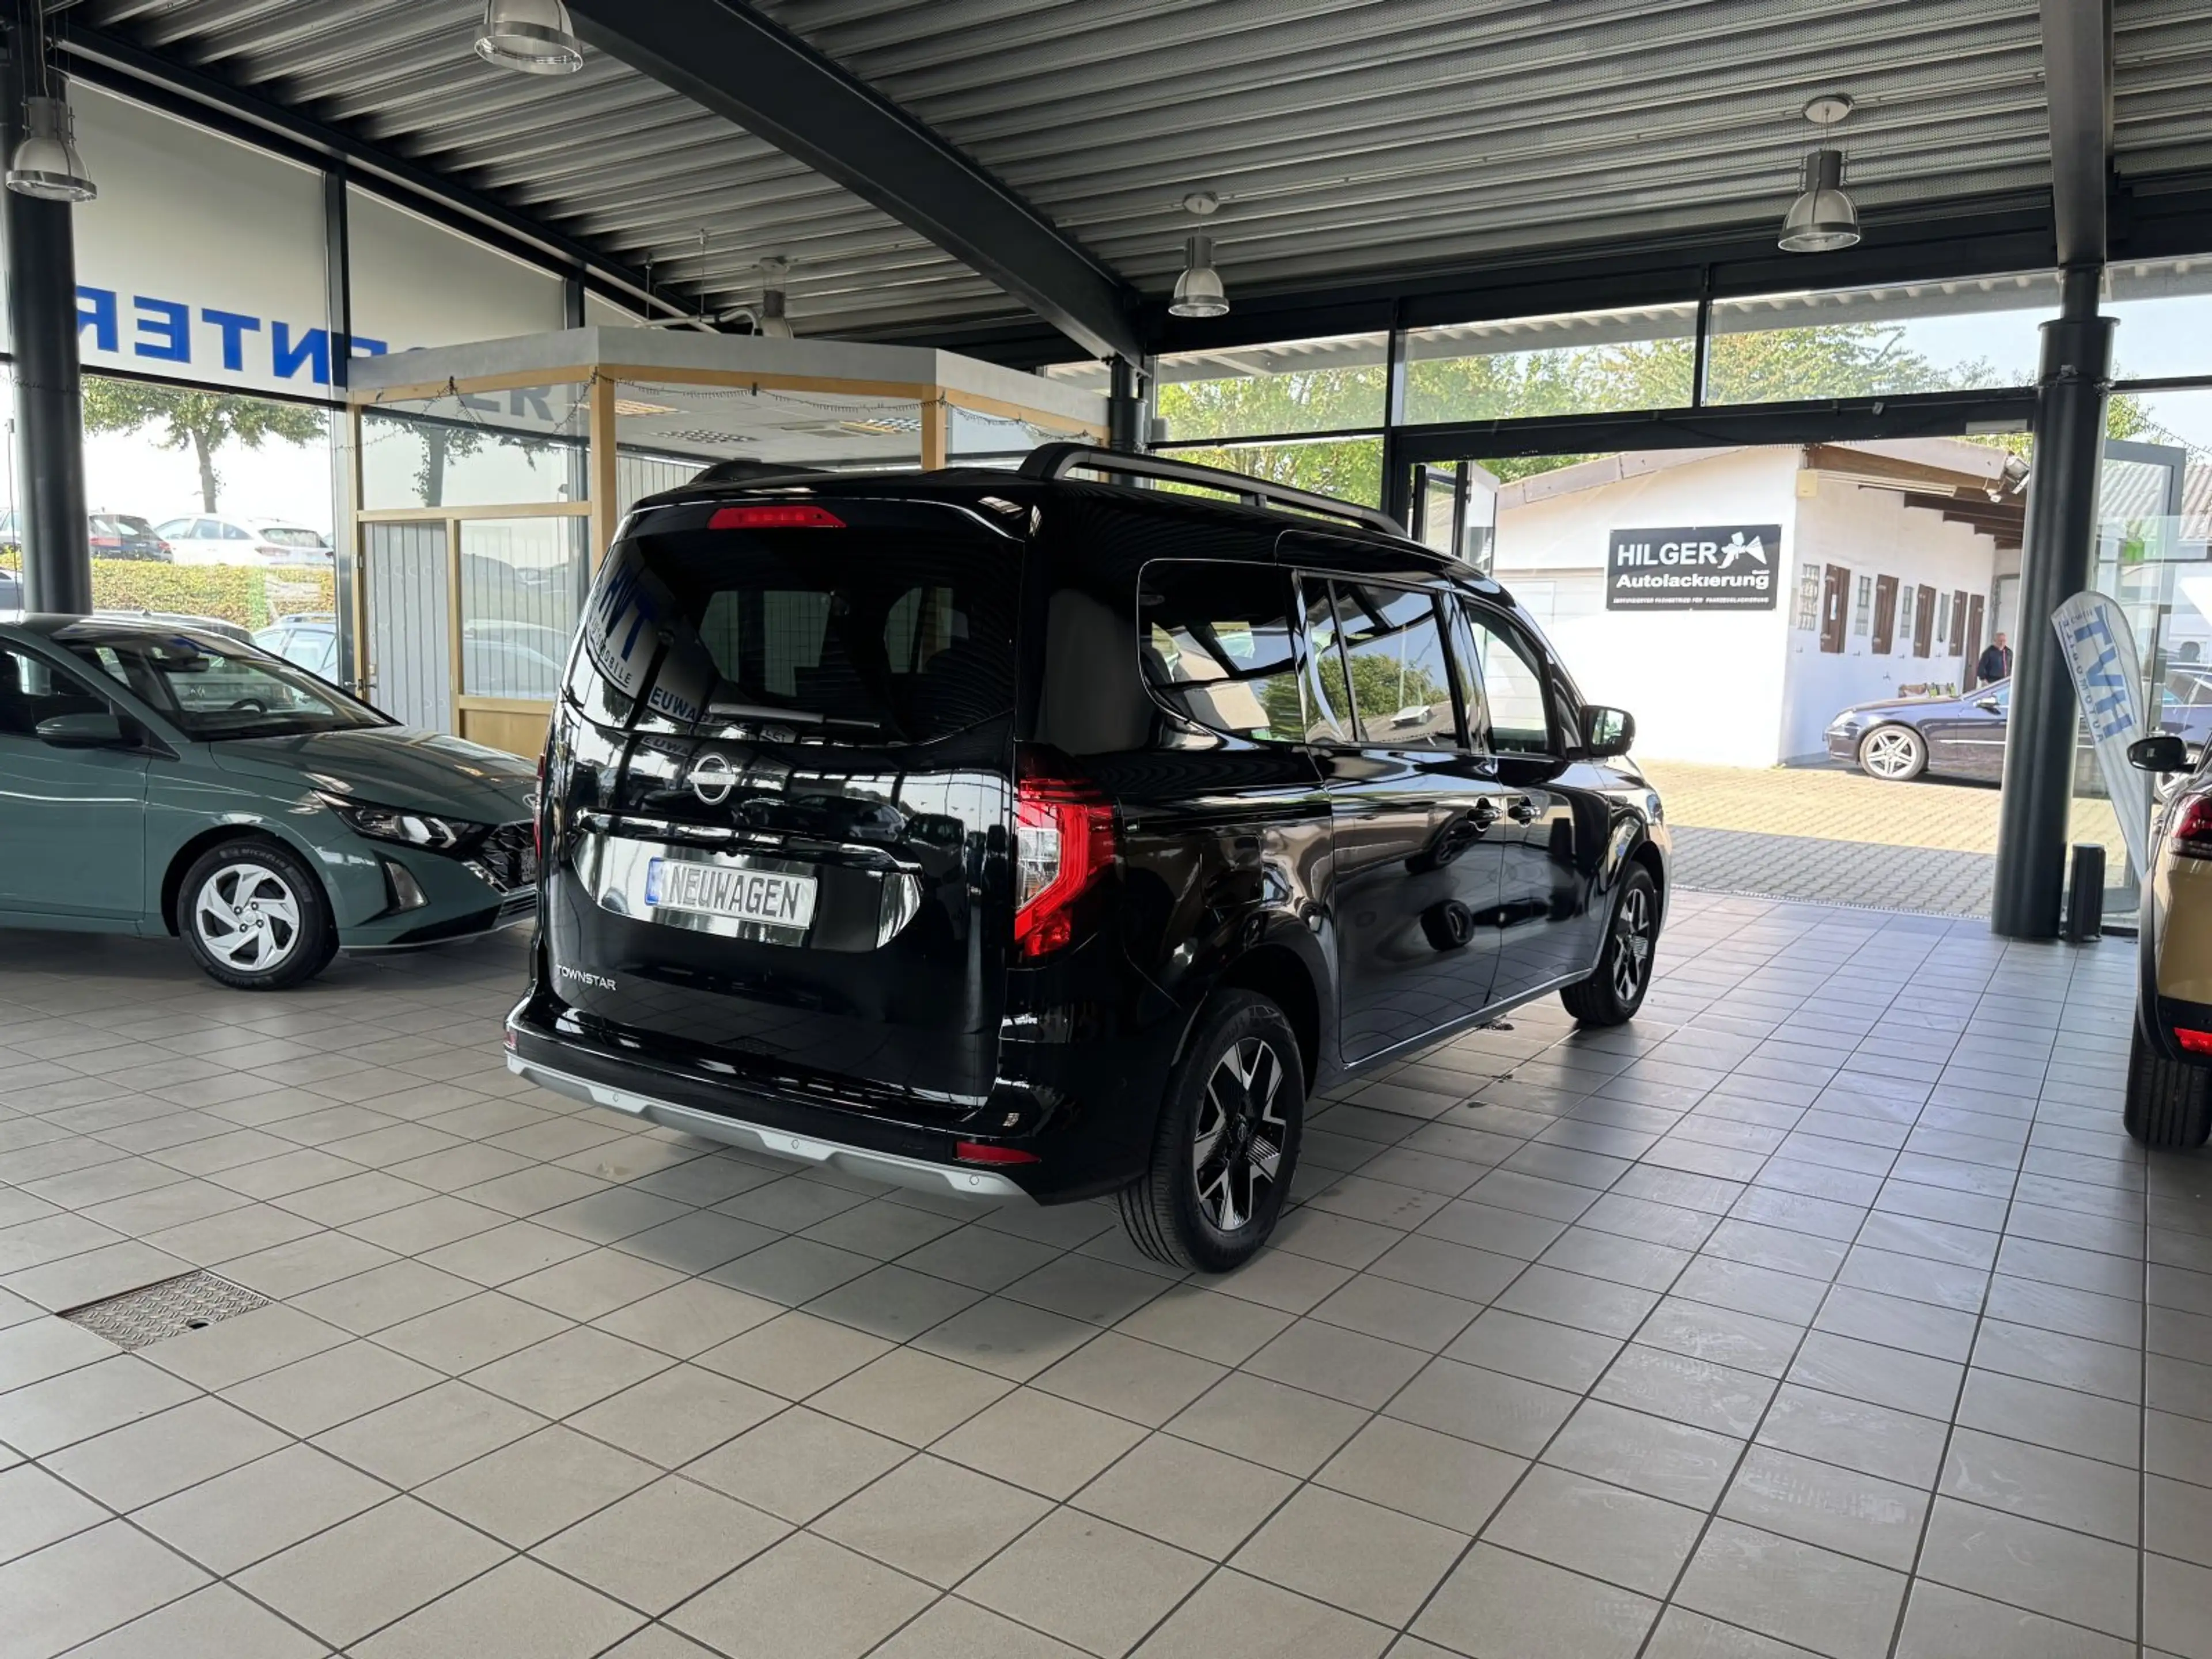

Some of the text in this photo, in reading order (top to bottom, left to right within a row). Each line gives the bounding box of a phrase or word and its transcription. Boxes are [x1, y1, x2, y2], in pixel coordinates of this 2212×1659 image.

[1617, 541, 1718, 566] HILGER
[1616, 573, 1770, 590] Autolackierung
[669, 866, 800, 920] NEUWAGEN
[555, 964, 617, 991] TOWNSTAR
